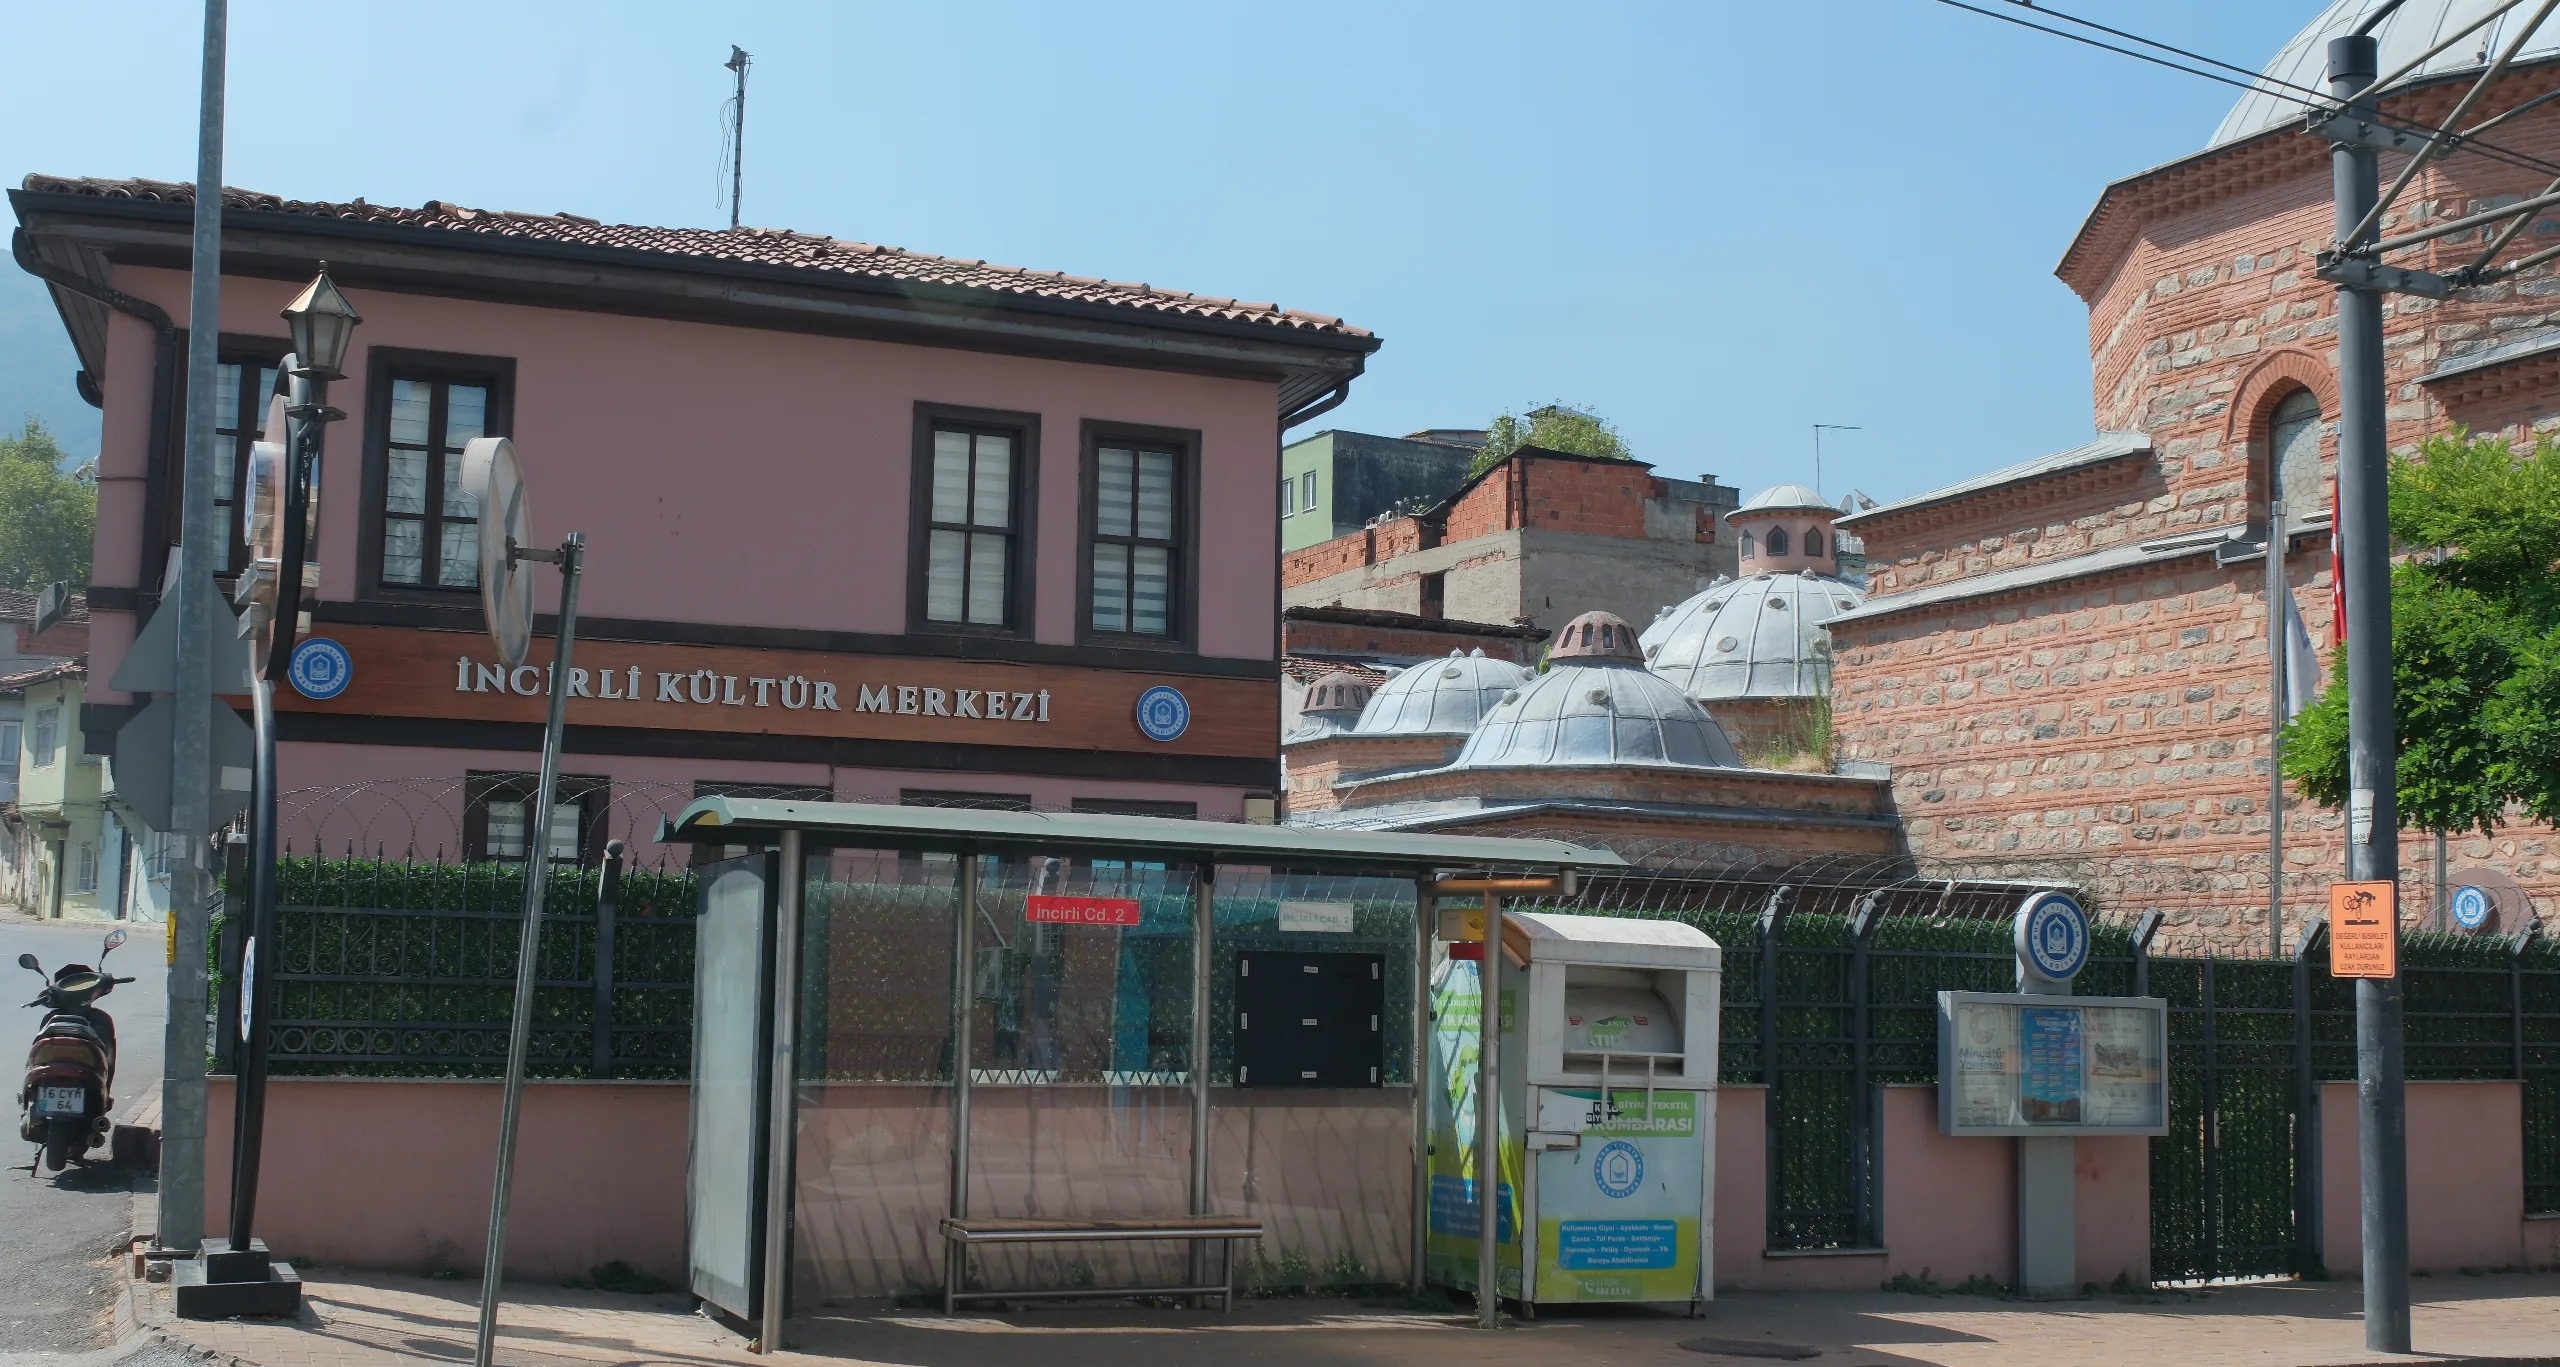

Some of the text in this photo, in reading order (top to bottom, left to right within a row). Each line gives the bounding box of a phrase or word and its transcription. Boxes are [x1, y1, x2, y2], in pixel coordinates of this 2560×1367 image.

[656, 669, 841, 711] KÜLTÜR
[855, 683, 1050, 722] MERKEZİ
[1036, 904, 1125, 922] İncirli Cd. 2
[1344, 916, 1351, 924] 2
[42, 1089, 55, 1099] 16
[57, 1100, 72, 1110] 64
[1652, 1100, 1690, 1111] TEKSTİL
